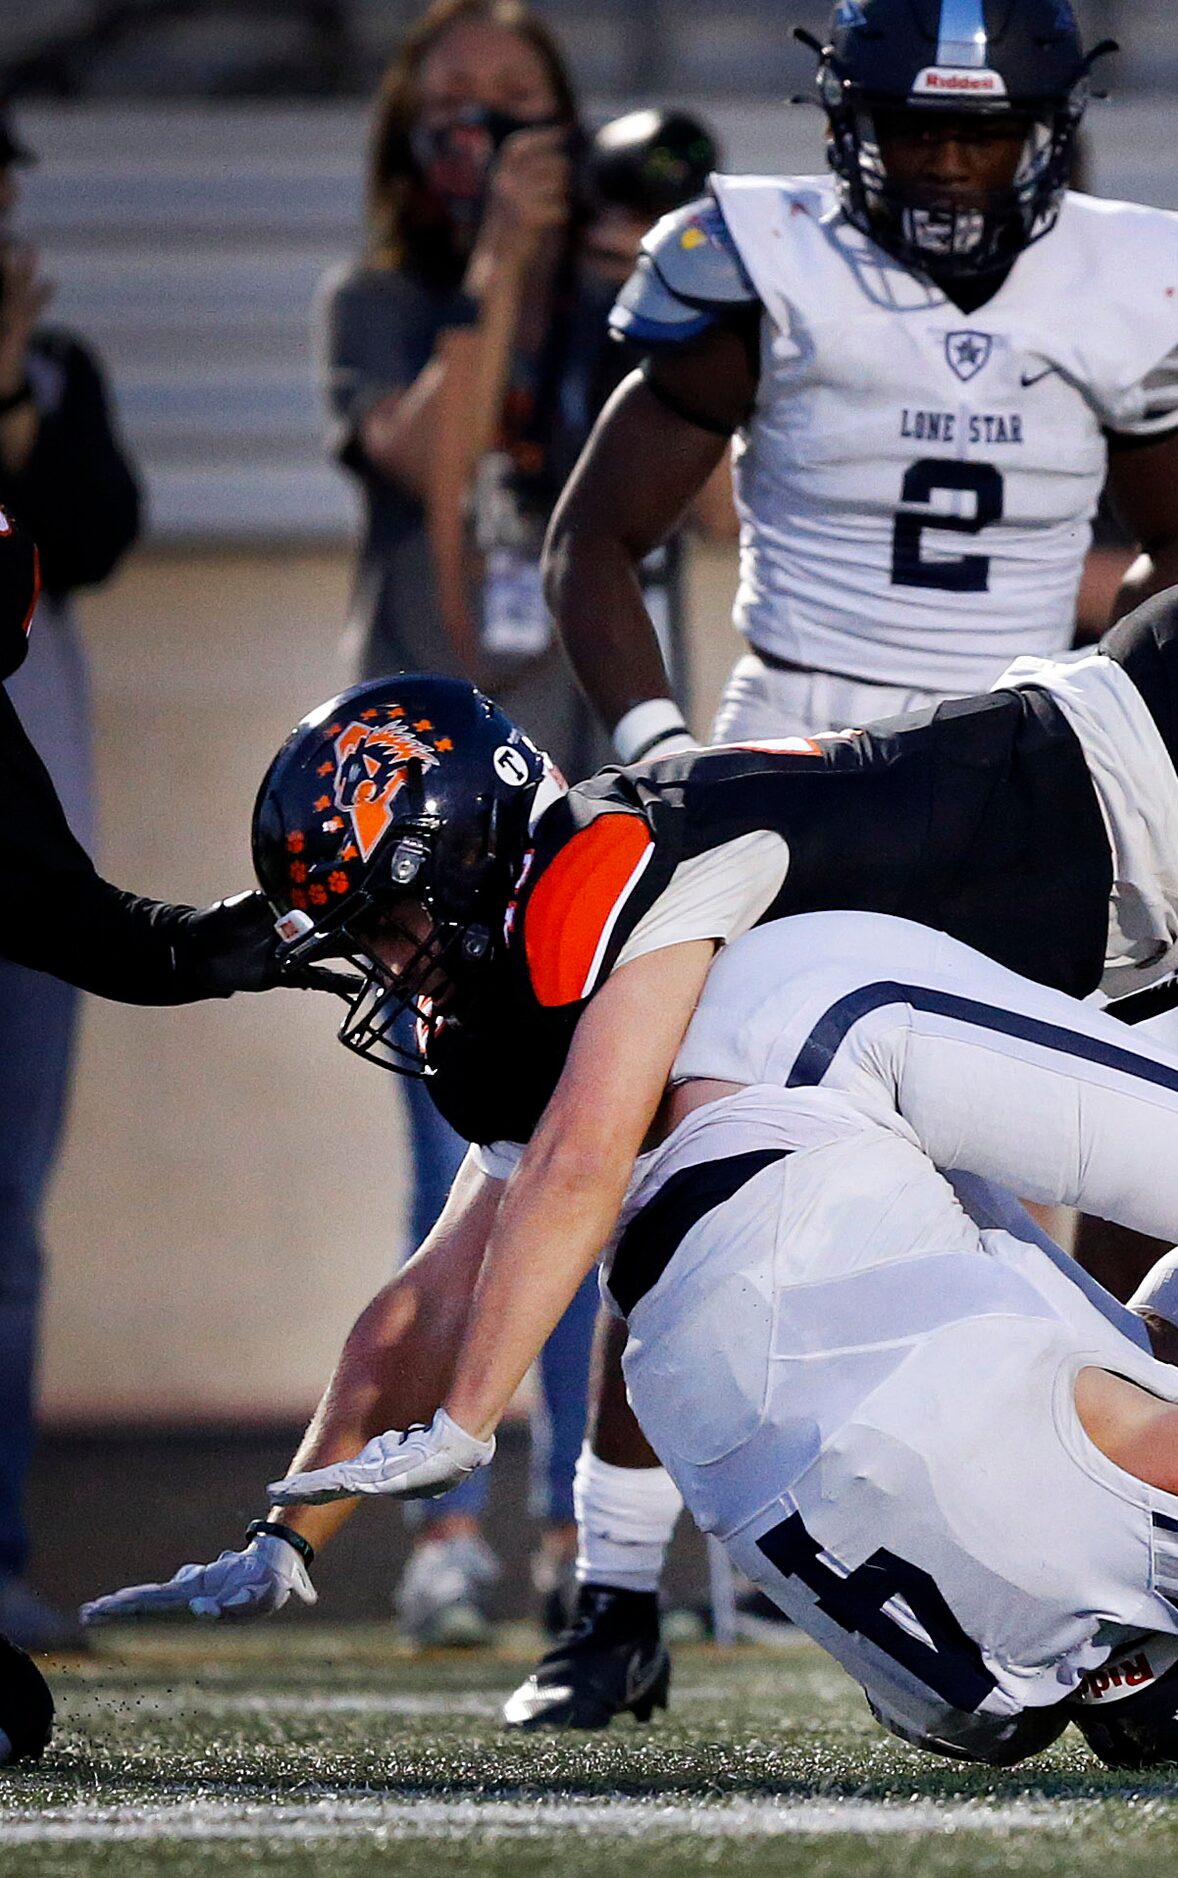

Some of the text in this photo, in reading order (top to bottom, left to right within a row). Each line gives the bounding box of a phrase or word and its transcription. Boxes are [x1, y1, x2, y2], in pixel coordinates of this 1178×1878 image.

[902, 410, 1024, 443] LONE STAR
[891, 458, 1003, 592] 2
[497, 749, 525, 782] T
[755, 1509, 1000, 1714] 4
